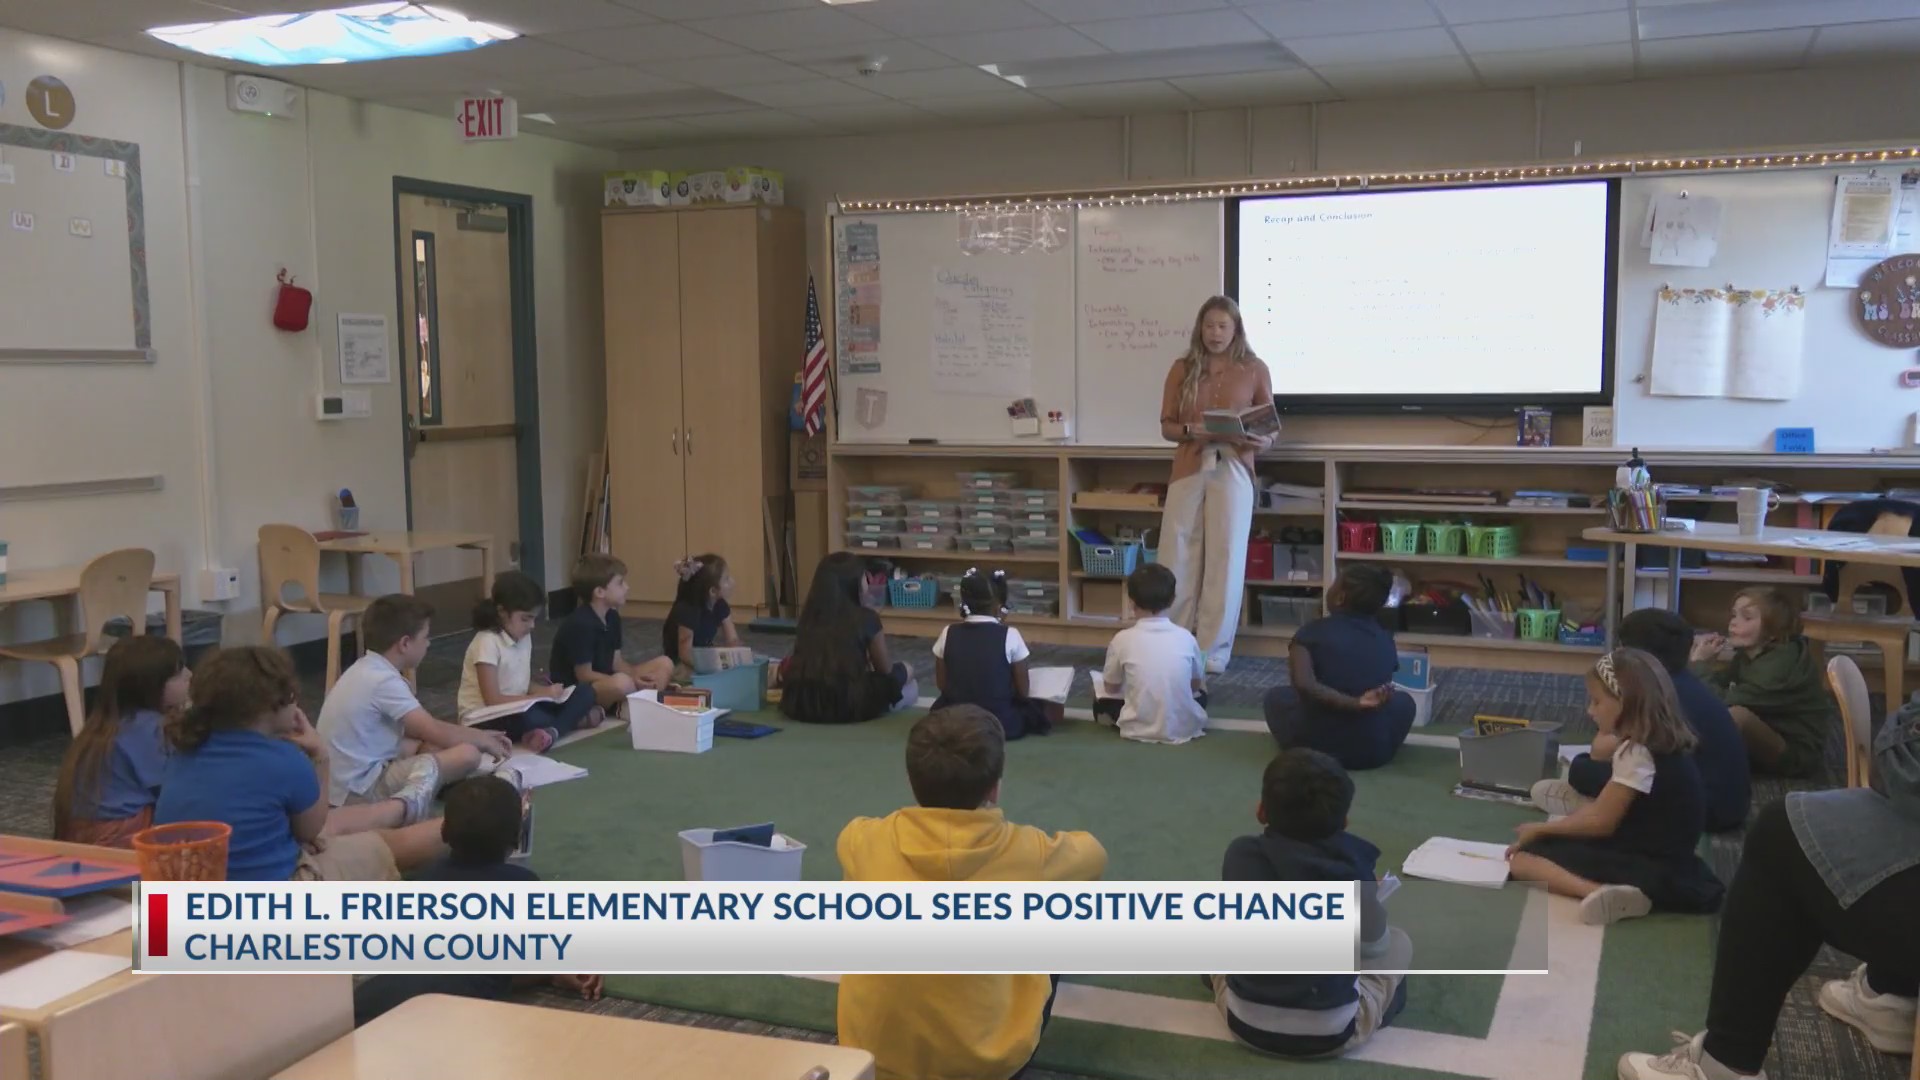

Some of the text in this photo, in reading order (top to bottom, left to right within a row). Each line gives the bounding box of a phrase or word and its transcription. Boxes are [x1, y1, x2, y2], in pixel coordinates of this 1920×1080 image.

[44, 90, 61, 118] L
[464, 98, 504, 137] EXIT
[15, 211, 33, 228] Uu
[1264, 210, 1373, 225] Recap and Conclusion
